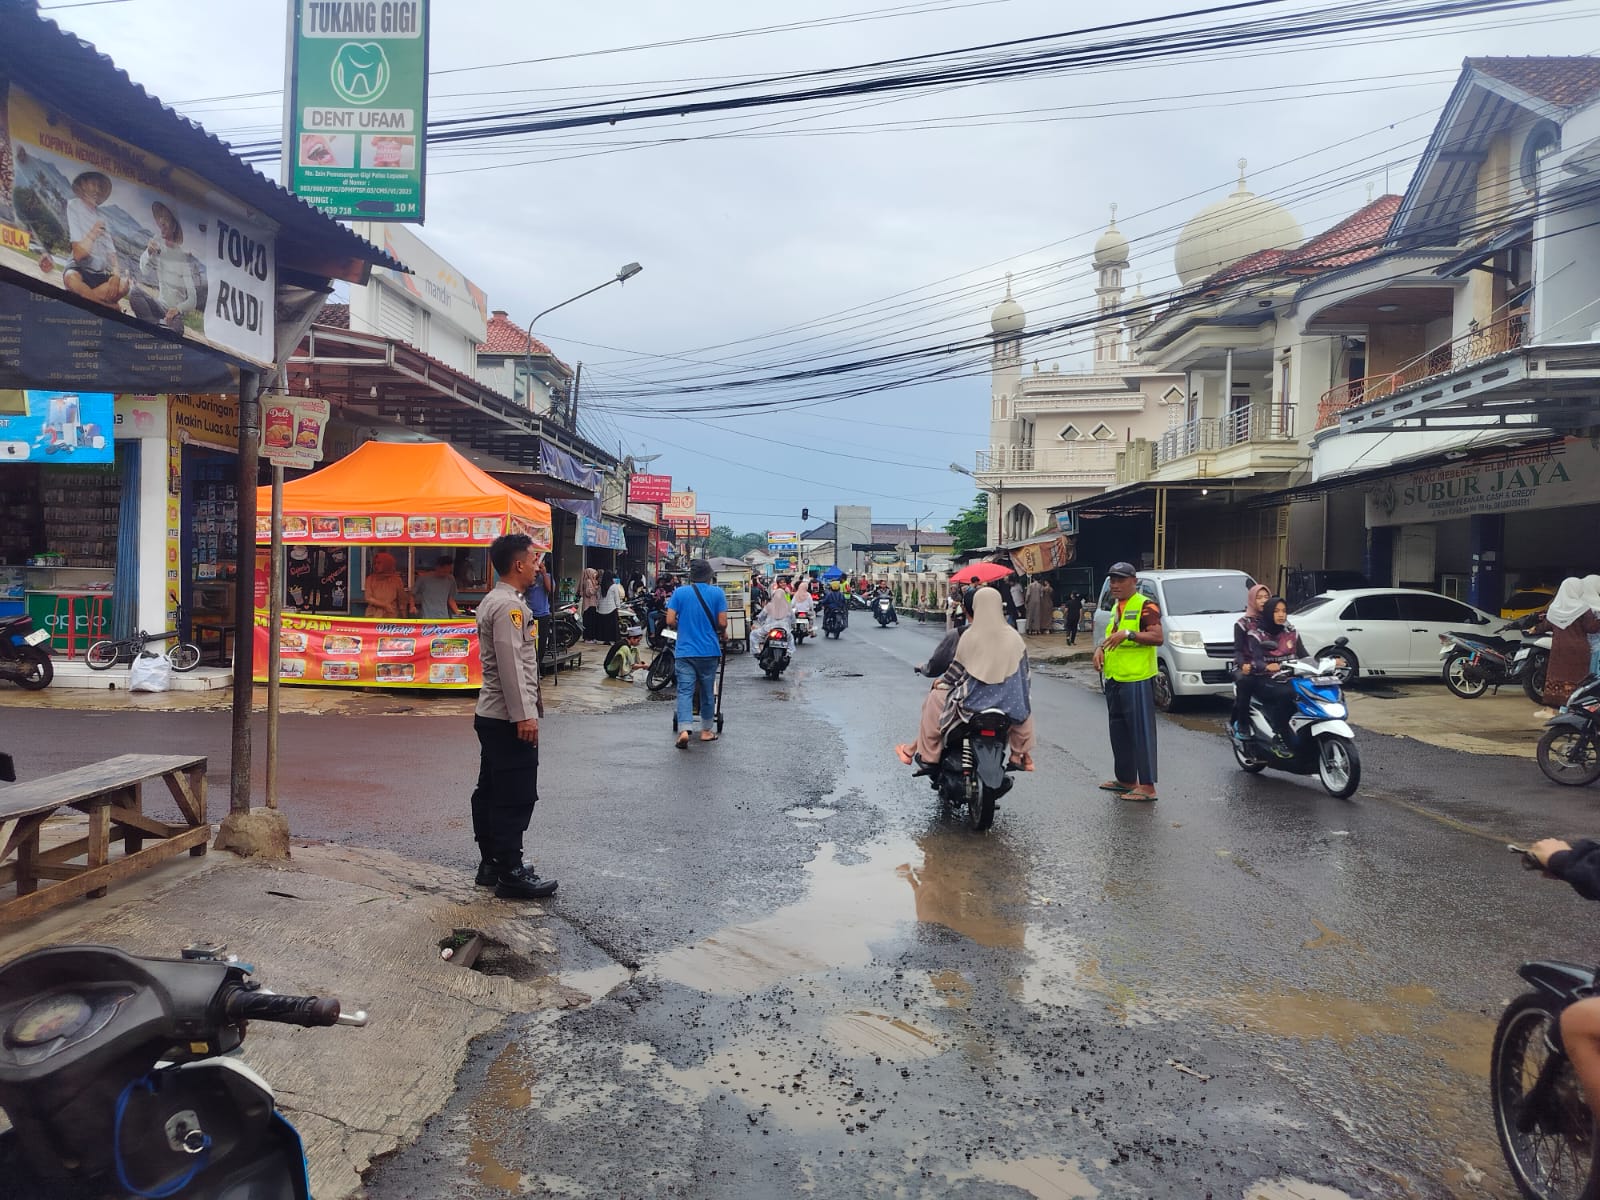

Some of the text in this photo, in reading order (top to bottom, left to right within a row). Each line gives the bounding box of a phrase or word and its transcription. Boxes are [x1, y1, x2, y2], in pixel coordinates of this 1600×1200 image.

[308, 1, 417, 34] TUKANG GIGI
[311, 110, 406, 129] DENT UFAM
[395, 203, 416, 212] 10 M
[216, 219, 268, 282] TOKO
[215, 279, 264, 336] RUDI
[195, 397, 234, 418] Jaringan
[269, 408, 290, 418] Deli
[175, 411, 203, 430] Makin
[203, 417, 224, 435] Luas
[224, 425, 232, 437] &
[1403, 460, 1573, 506] SUBUR JAYA
[44, 614, 107, 630] oppo
[254, 615, 333, 632] MRJAN
